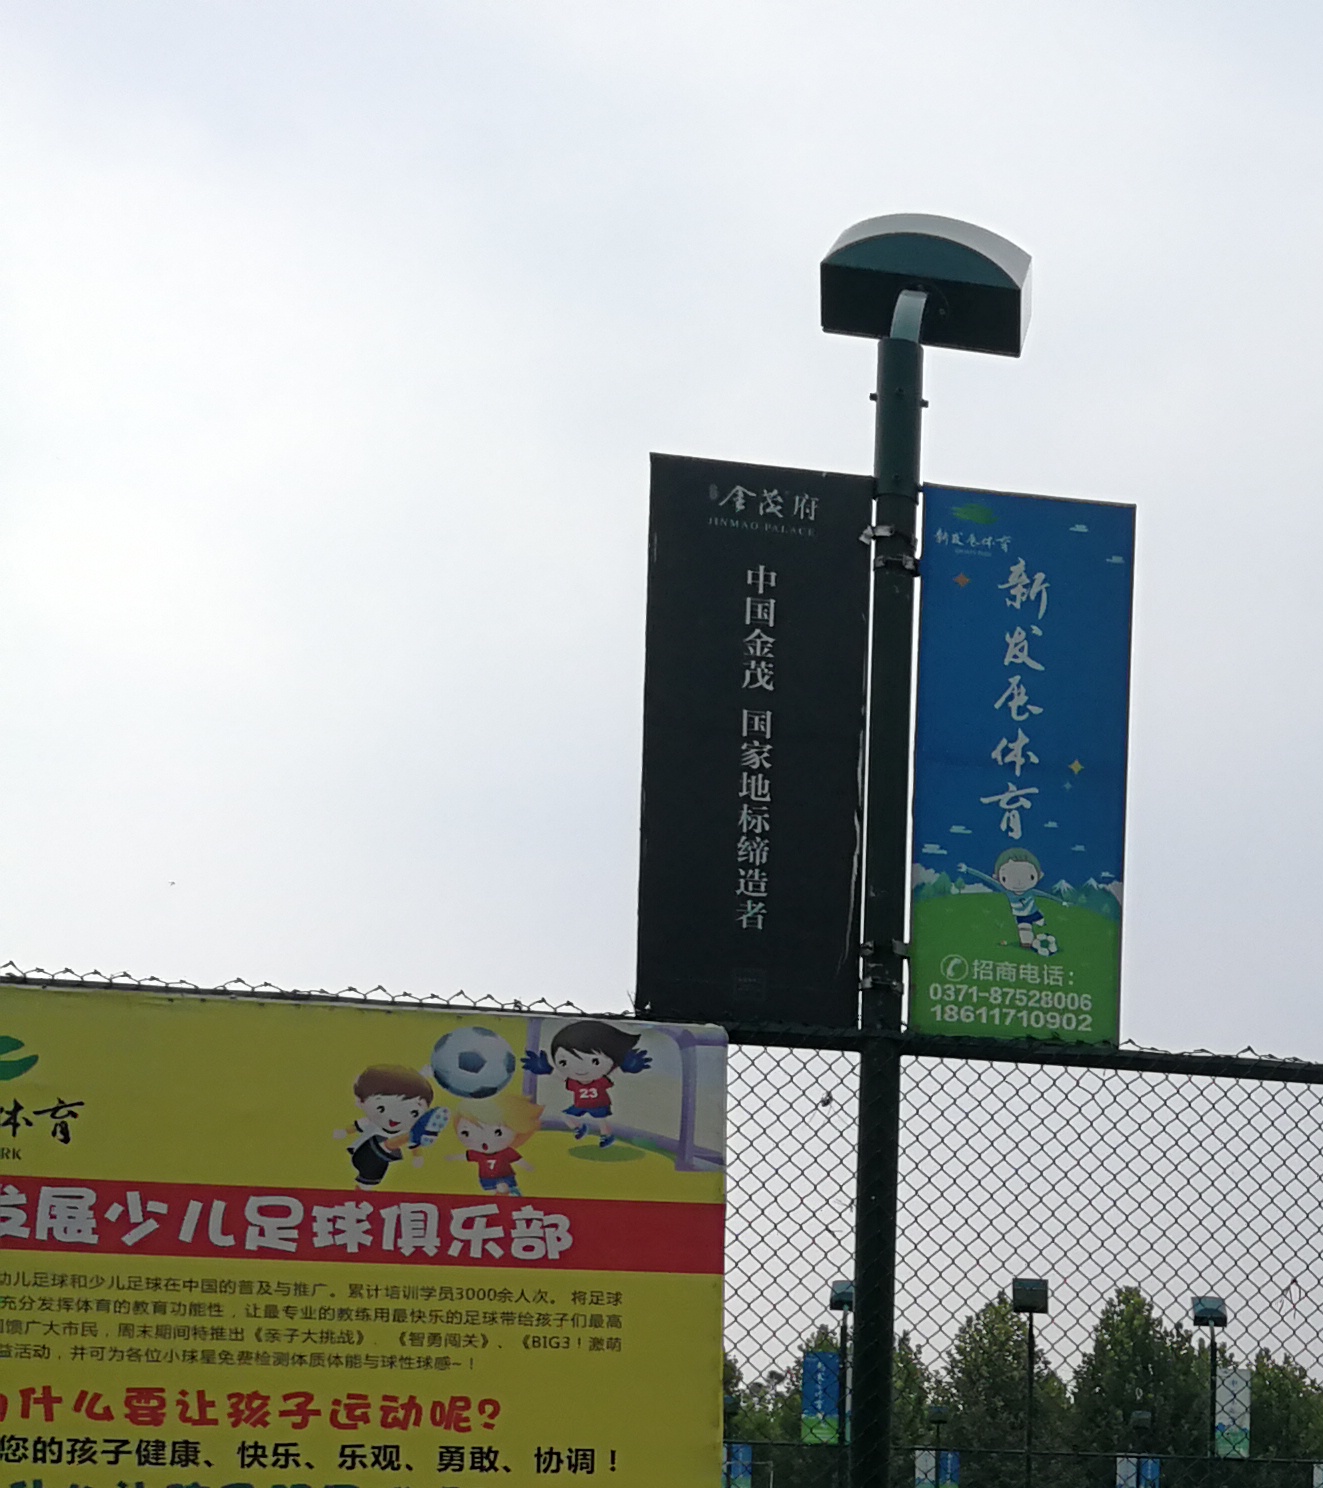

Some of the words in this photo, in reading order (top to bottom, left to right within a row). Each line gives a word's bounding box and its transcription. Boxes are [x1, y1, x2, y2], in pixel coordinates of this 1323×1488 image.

[718, 485, 820, 521] 金茂府
[708, 517, 759, 531] JINMAO
[764, 523, 816, 536] PALACE
[741, 564, 778, 692] 中国金茂
[980, 557, 1050, 840] 新发展体育
[735, 708, 773, 931] 国家地标缔造者
[929, 983, 1093, 1010] 0371-87528006
[930, 1004, 1093, 1031] 18611710902
[579, 1088, 600, 1099] 23
[486, 1159, 497, 1170] 7
[0, 1385, 501, 1433] 什么要让孩子运动呢?
